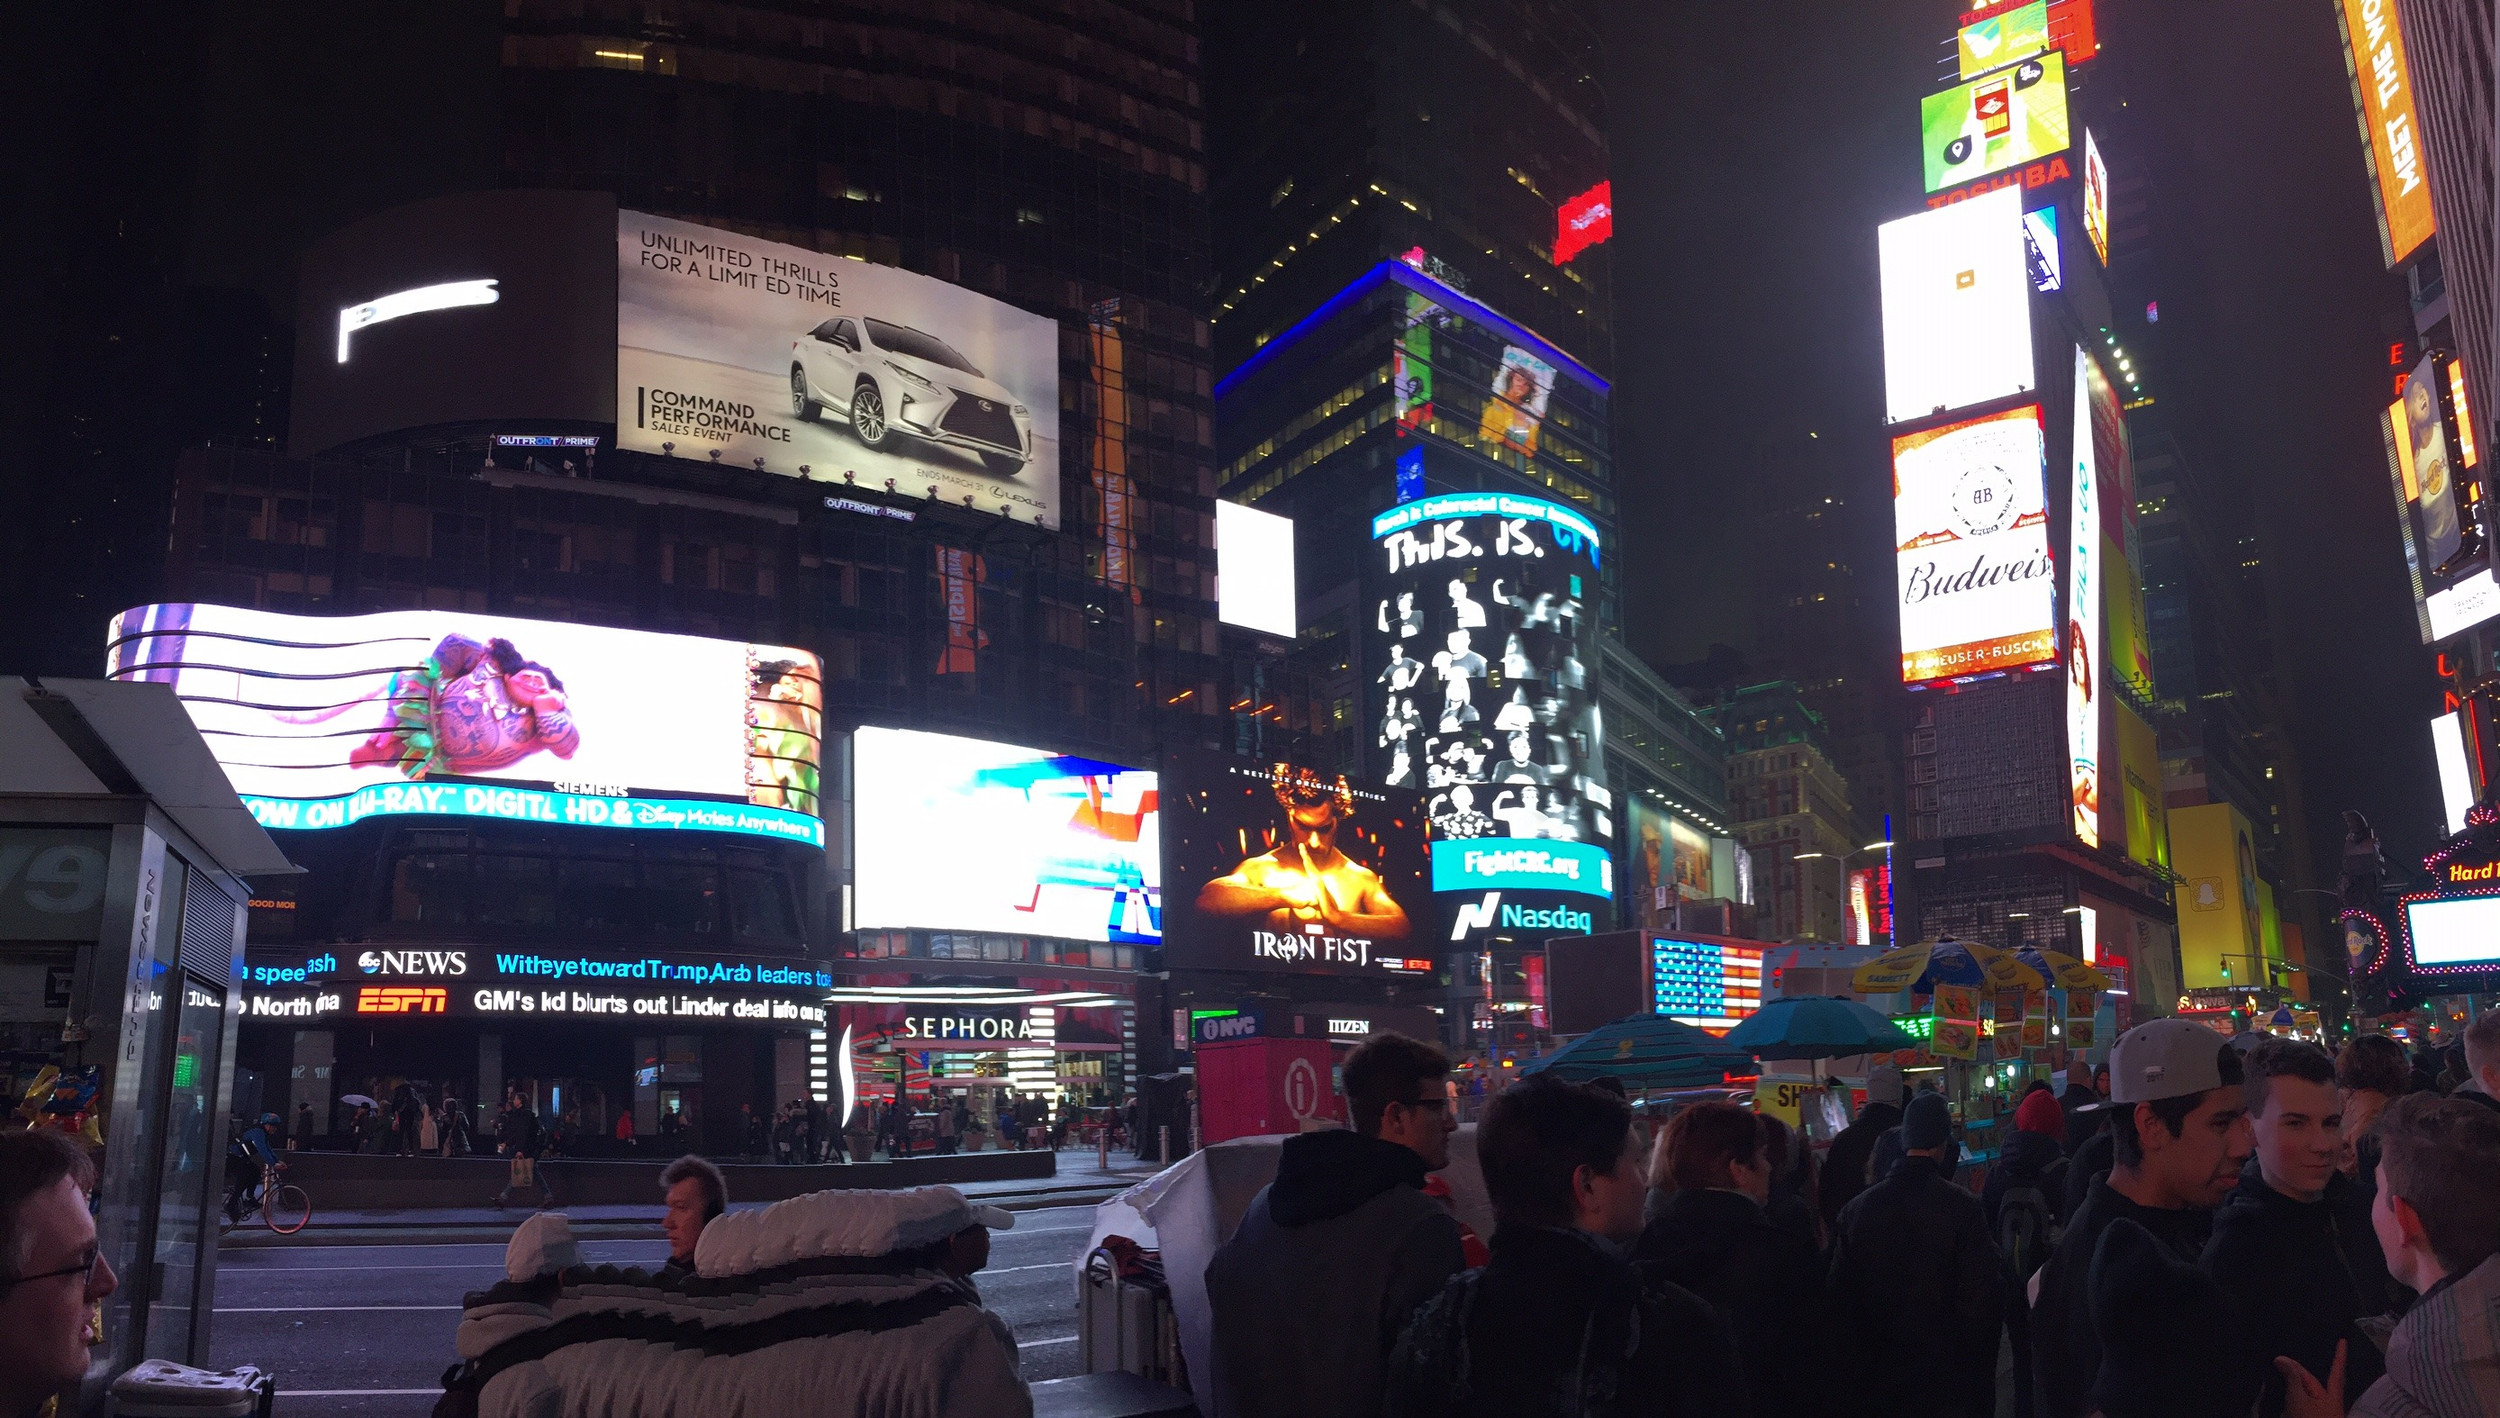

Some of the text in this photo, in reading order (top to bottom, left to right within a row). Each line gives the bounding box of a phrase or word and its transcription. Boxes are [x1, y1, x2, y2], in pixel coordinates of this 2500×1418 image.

[2372, 41, 2399, 110] THE
[2385, 113, 2420, 197] MEET
[641, 230, 839, 288] UNLIMITED THRILLS
[641, 251, 841, 308] FOR A LIMITED TIME
[651, 389, 755, 419] COMMAND
[651, 405, 791, 442] PERFORMANCE
[651, 421, 733, 442] SALES EVENT
[499, 436, 595, 445] OUTFRONT PRIME
[917, 468, 941, 480] ENDS
[942, 474, 973, 490] MARCH
[826, 498, 912, 520] OUTFRONT PRIME
[1005, 490, 1047, 509] LEXUS
[554, 781, 628, 797] SIEMENS
[306, 801, 344, 827] ON
[566, 798, 609, 823] HD
[611, 799, 633, 825] &
[2449, 862, 2493, 882] Hard
[248, 899, 275, 908] GOOD
[1502, 904, 1592, 935] Nasdaq
[1252, 931, 1371, 966] IRON FIST
[381, 951, 467, 975] NEWS
[757, 964, 813, 986] leaders
[252, 996, 312, 1016] North
[357, 987, 447, 1013] ESPN
[474, 989, 535, 1012] GM's
[633, 996, 668, 1016] out
[733, 998, 769, 1019] deal
[905, 1016, 1033, 1039] SEPHORA
